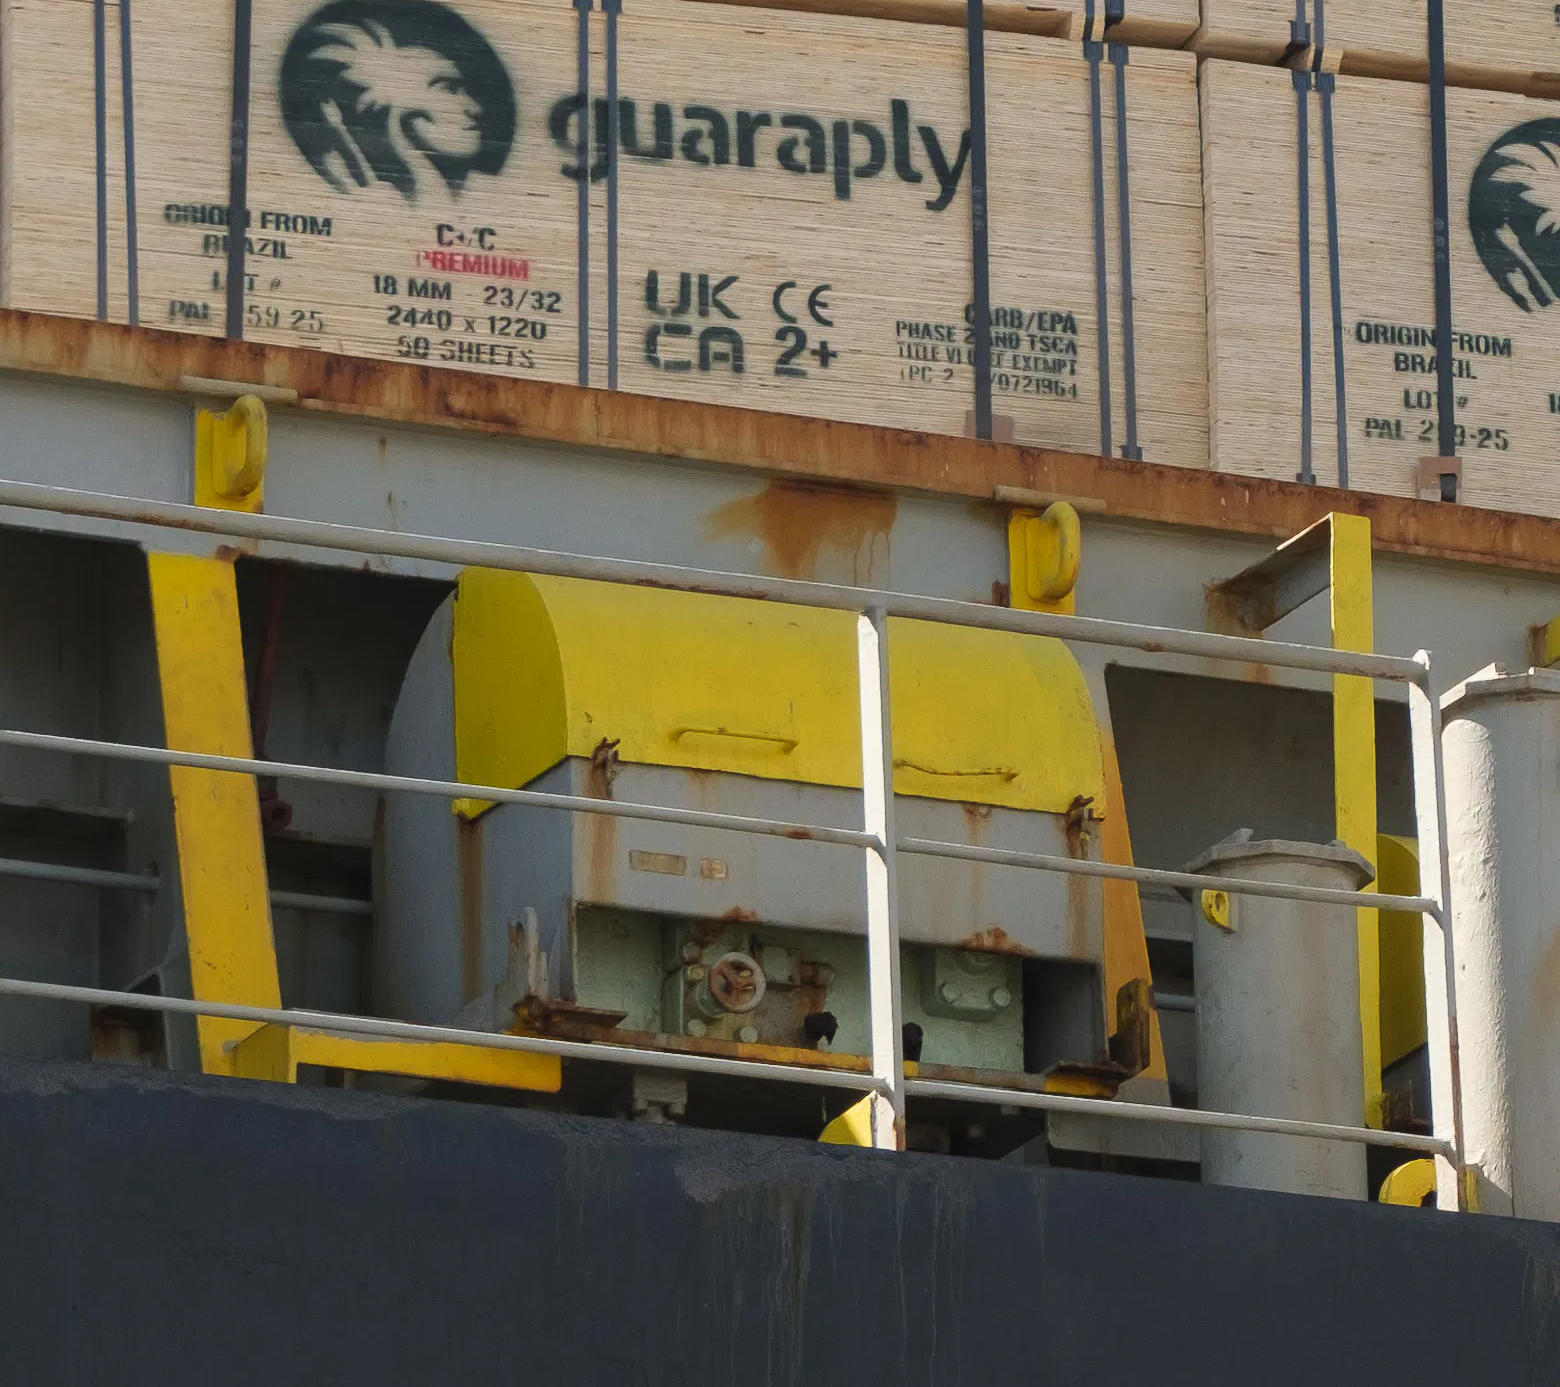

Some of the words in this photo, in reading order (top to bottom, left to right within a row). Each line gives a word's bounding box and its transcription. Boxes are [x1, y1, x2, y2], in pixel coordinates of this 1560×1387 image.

[548, 92, 972, 210] guaraply
[260, 210, 333, 237] FROM
[415, 250, 530, 280] PREMIUM
[372, 274, 398, 295] 18
[409, 278, 452, 300] MM
[484, 285, 562, 313] 23/32
[644, 269, 739, 320] UK
[387, 306, 452, 331] 2440
[489, 315, 548, 340] 1220
[896, 320, 956, 342] PHASE
[644, 323, 744, 374] CA
[774, 325, 838, 377] 2+
[1452, 331, 1512, 357] FROM
